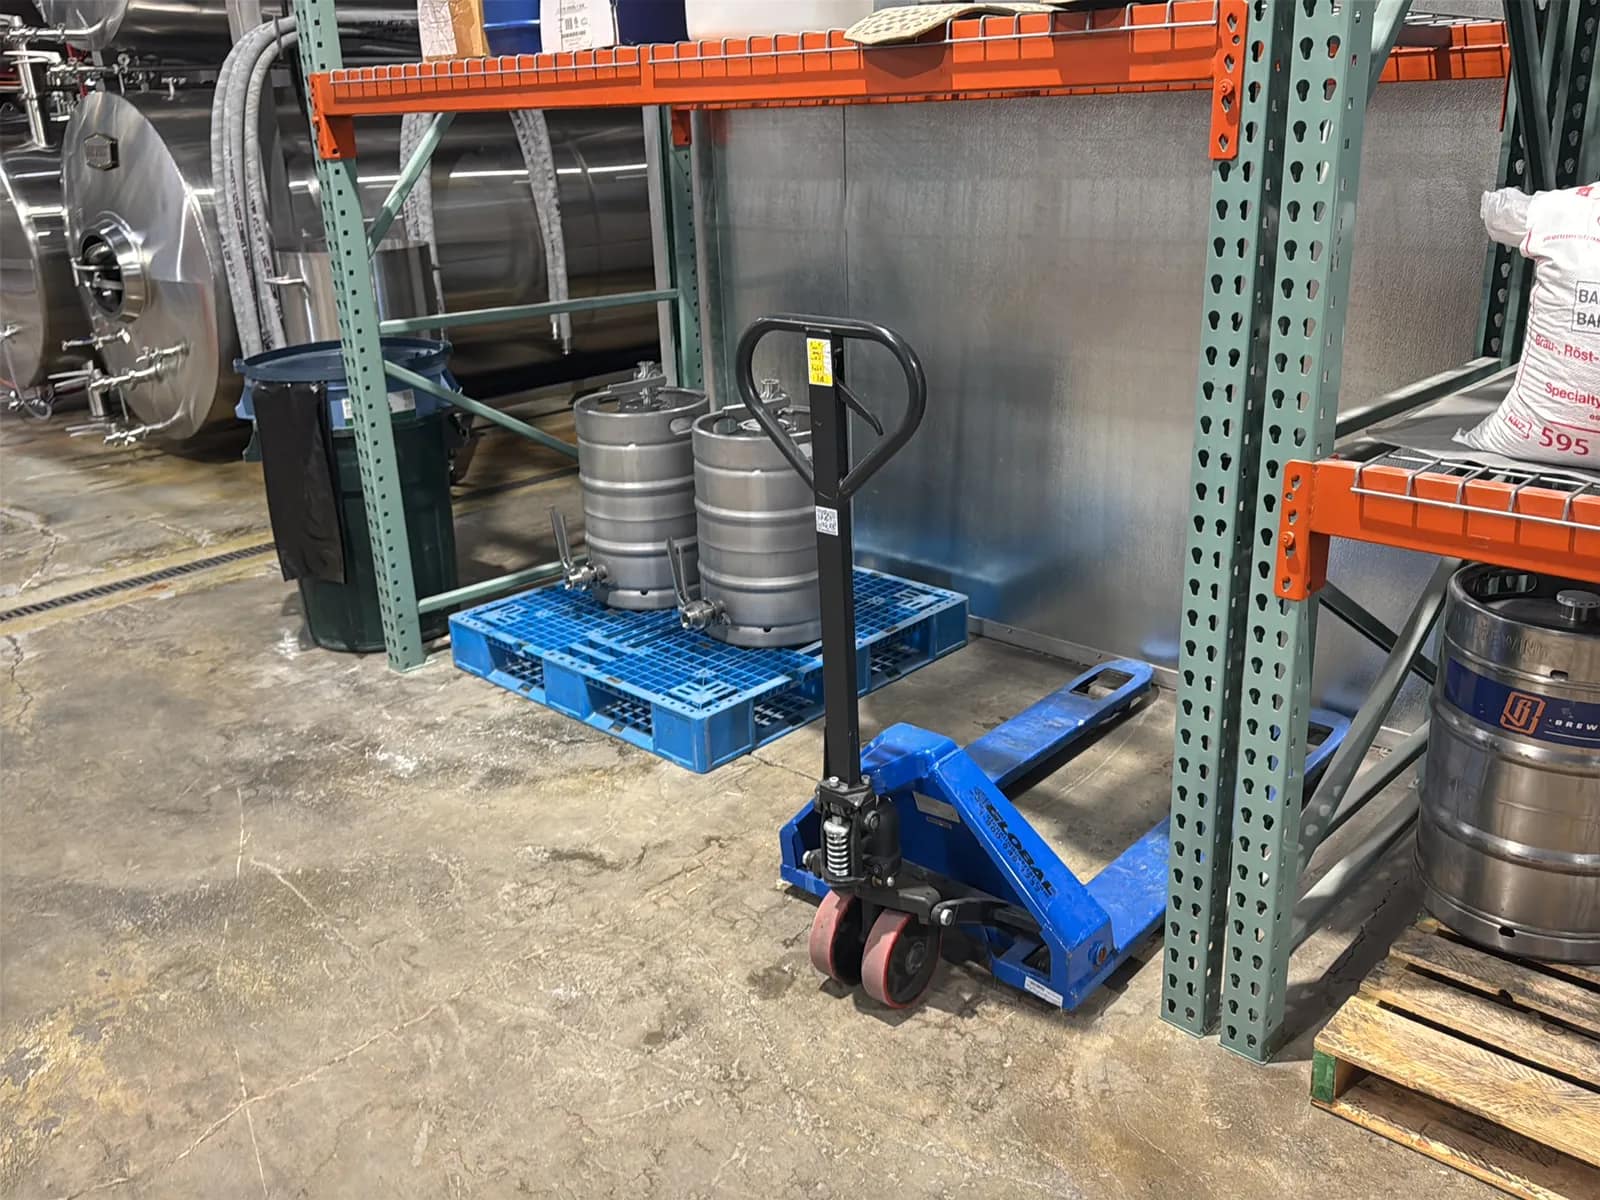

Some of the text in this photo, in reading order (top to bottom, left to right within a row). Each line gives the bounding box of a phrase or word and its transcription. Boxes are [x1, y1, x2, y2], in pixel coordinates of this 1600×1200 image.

[1578, 288, 1600, 305] BA
[1564, 343, 1600, 362] Röst-
[1545, 382, 1600, 409] Specialty
[1538, 426, 1590, 457] 595
[985, 803, 1055, 897] GLOBAL
